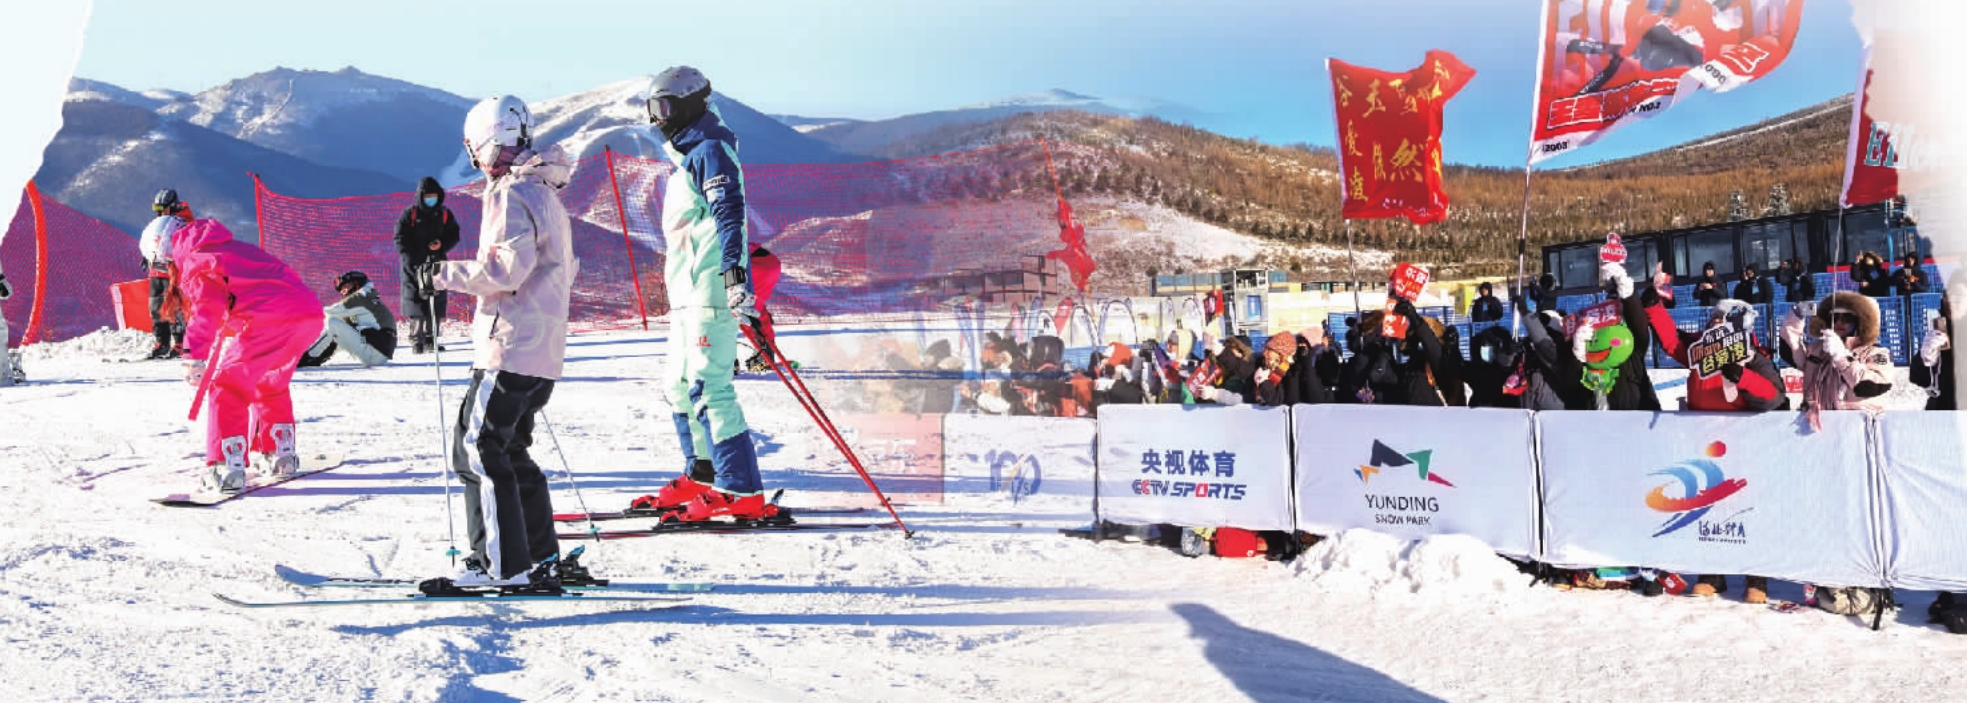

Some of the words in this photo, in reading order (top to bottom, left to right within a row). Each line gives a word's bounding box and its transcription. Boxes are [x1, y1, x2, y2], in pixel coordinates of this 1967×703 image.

[1141, 448, 1236, 478] 央视体育
[1132, 479, 1169, 497] CCTV
[1170, 481, 1247, 500] SPORTS
[1365, 494, 1440, 512] YUNDING
[1375, 514, 1404, 525] SNOW
[1406, 515, 1431, 526] PARK
